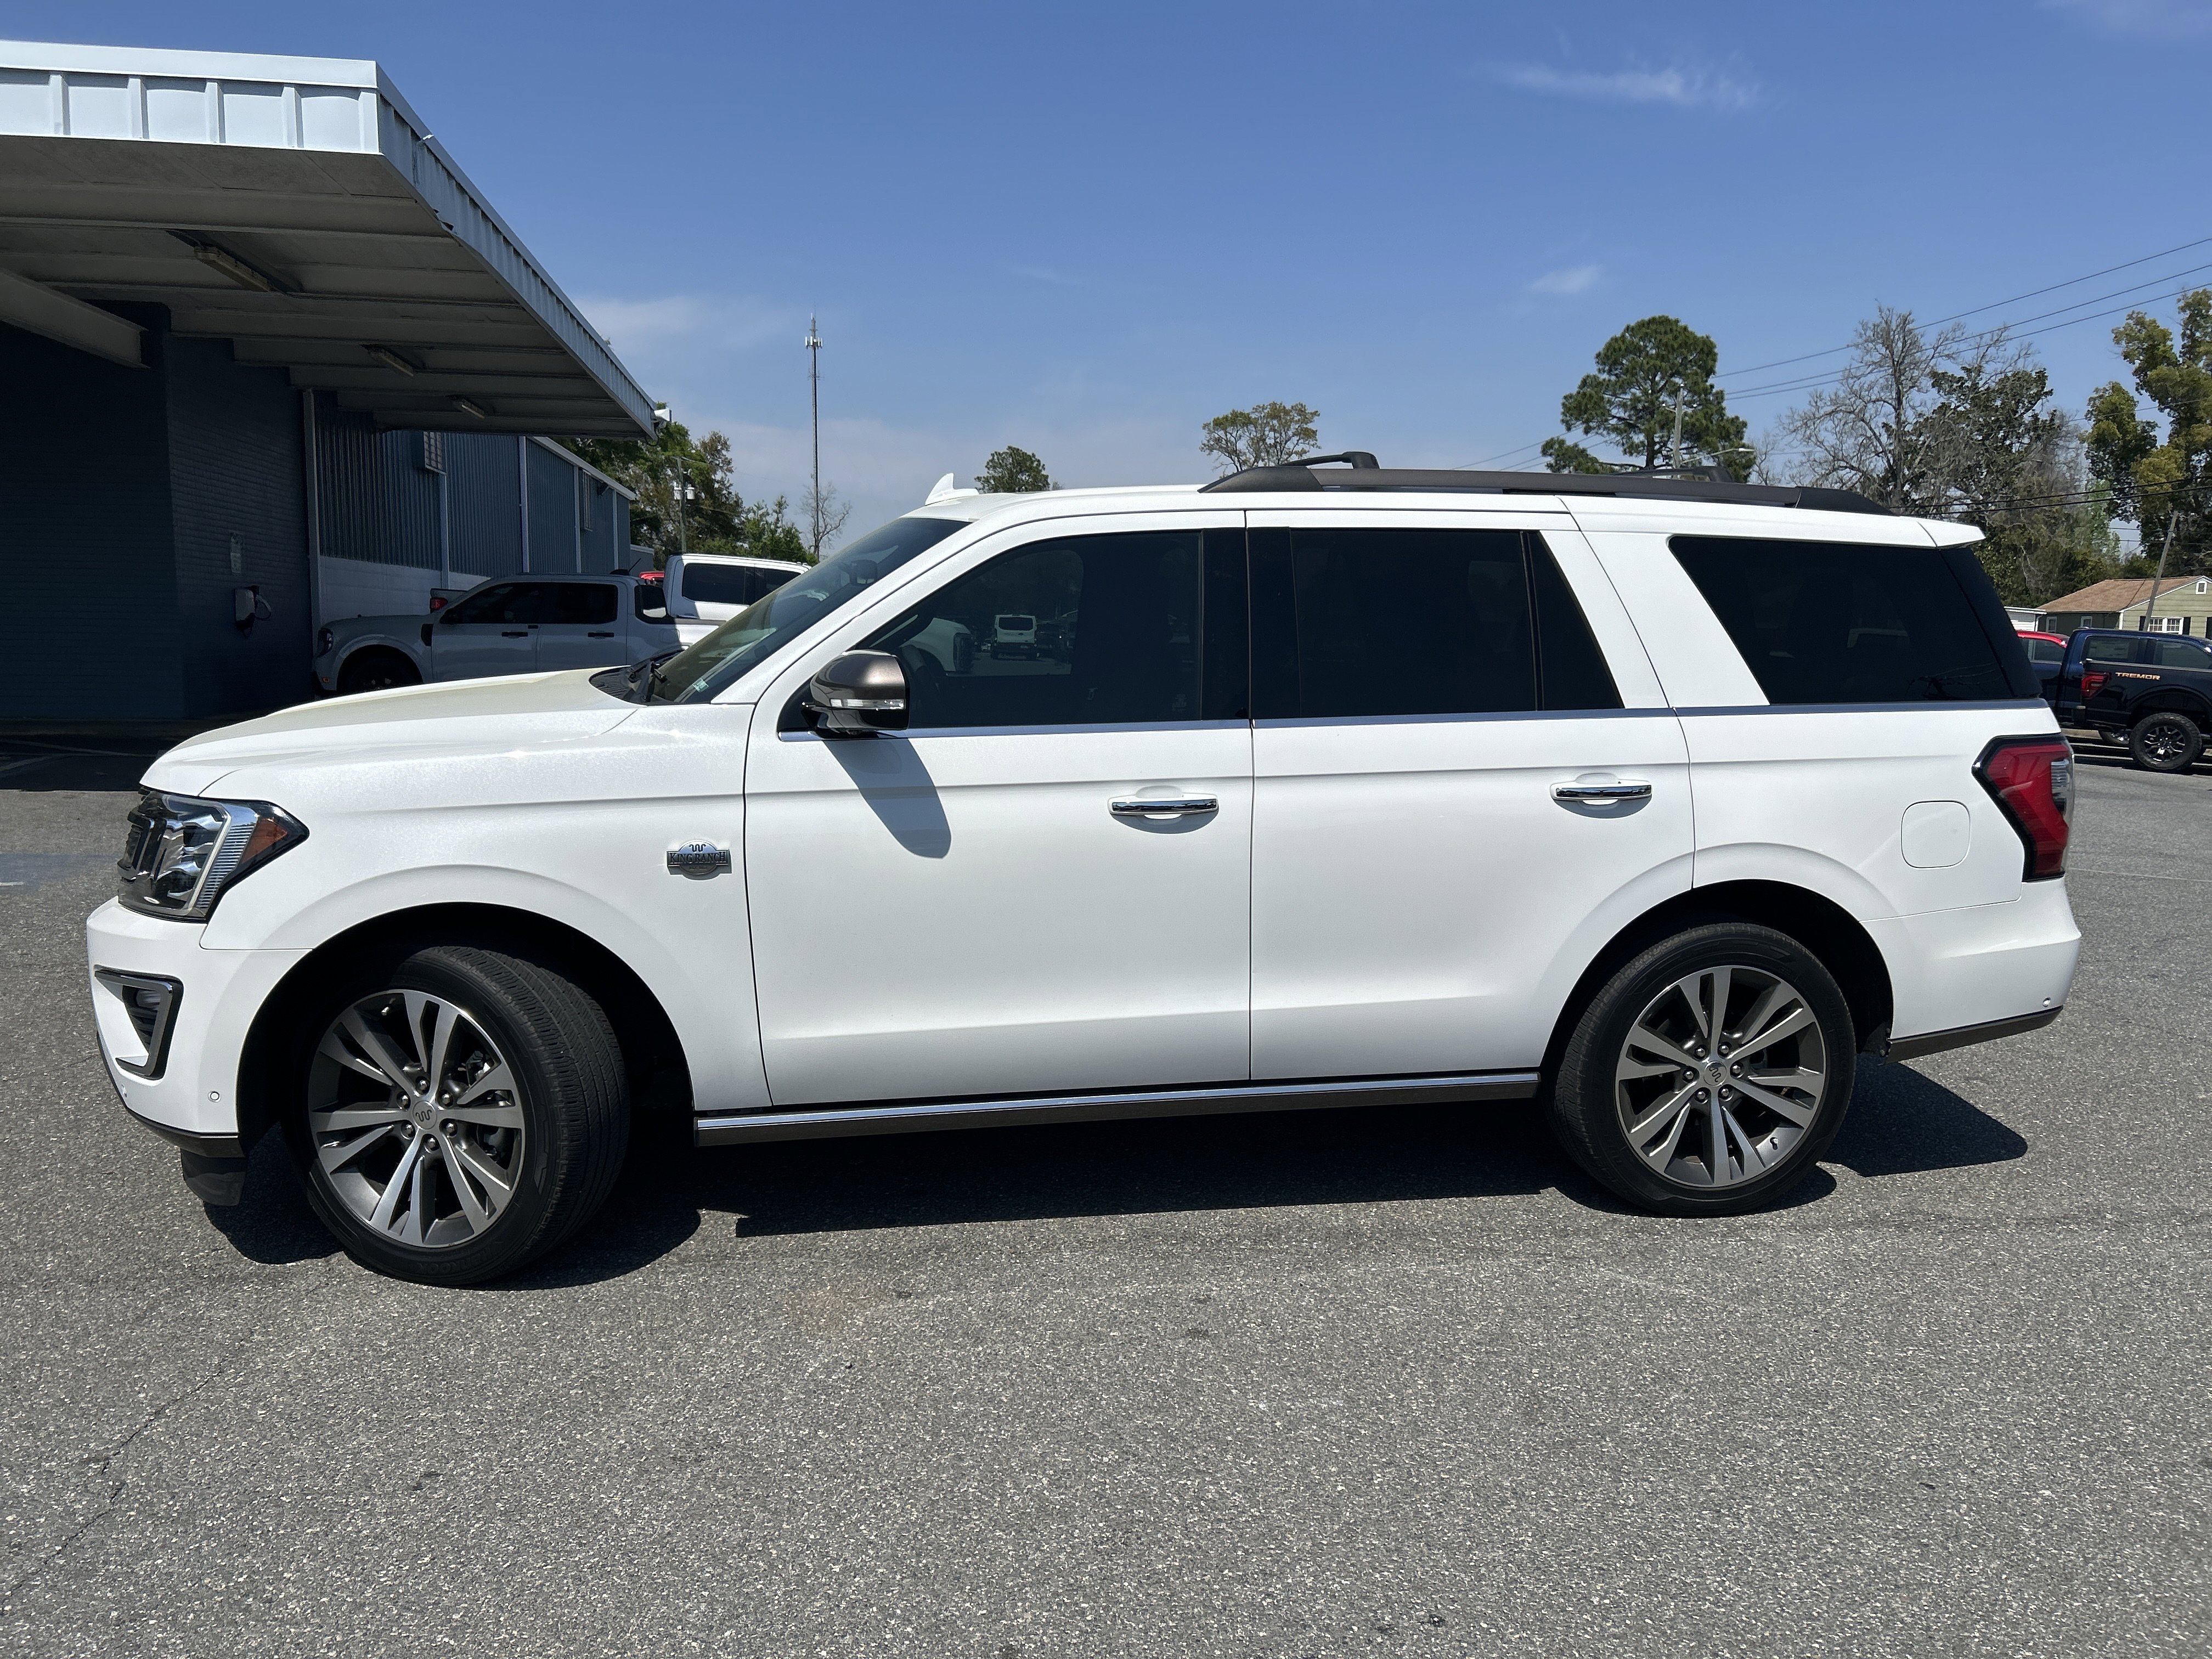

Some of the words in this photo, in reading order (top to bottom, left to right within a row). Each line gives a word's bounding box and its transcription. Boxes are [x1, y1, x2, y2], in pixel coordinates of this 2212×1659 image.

[2115, 672, 2160, 680] TREMOR
[669, 853, 692, 864] KING
[695, 851, 726, 862] RANCH
